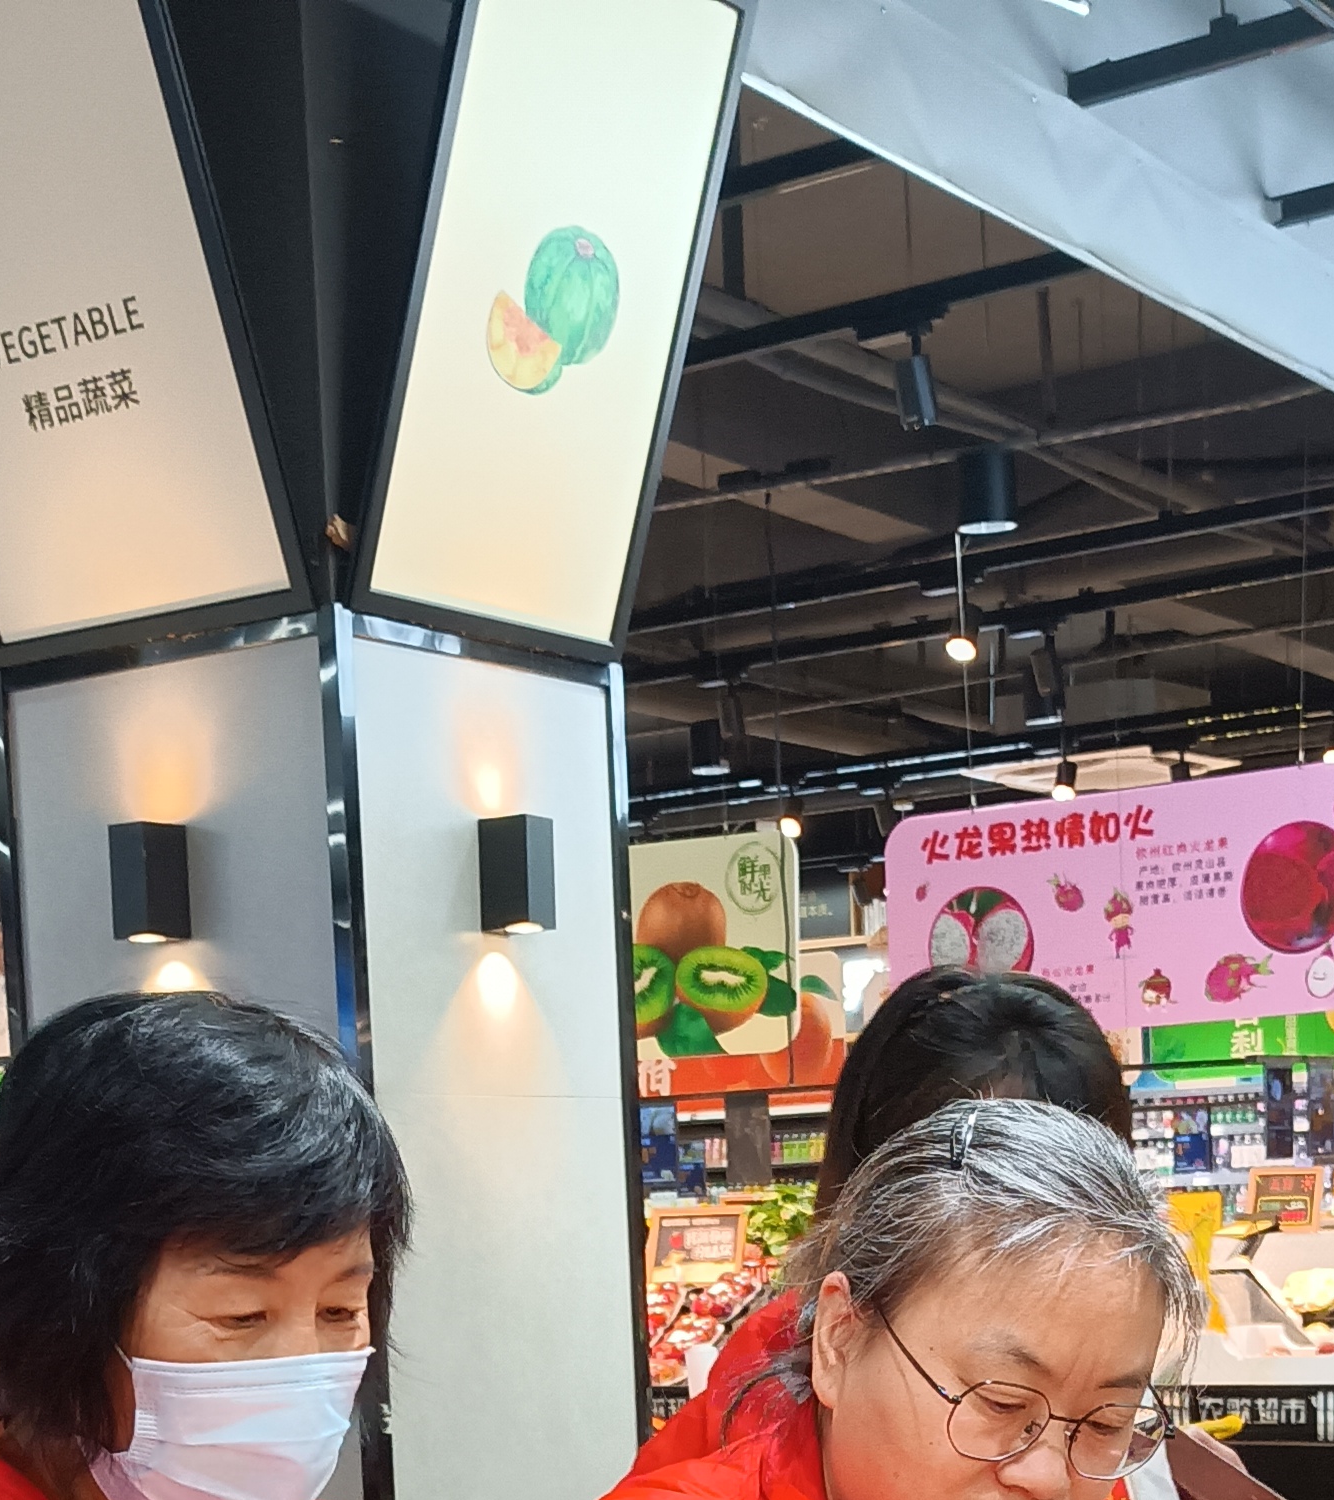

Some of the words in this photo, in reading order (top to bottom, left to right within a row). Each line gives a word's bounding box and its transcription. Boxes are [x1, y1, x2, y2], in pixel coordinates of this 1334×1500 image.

[22, 368, 141, 433] 精品蔬菜
[921, 805, 1154, 865] 火龙果热情如火
